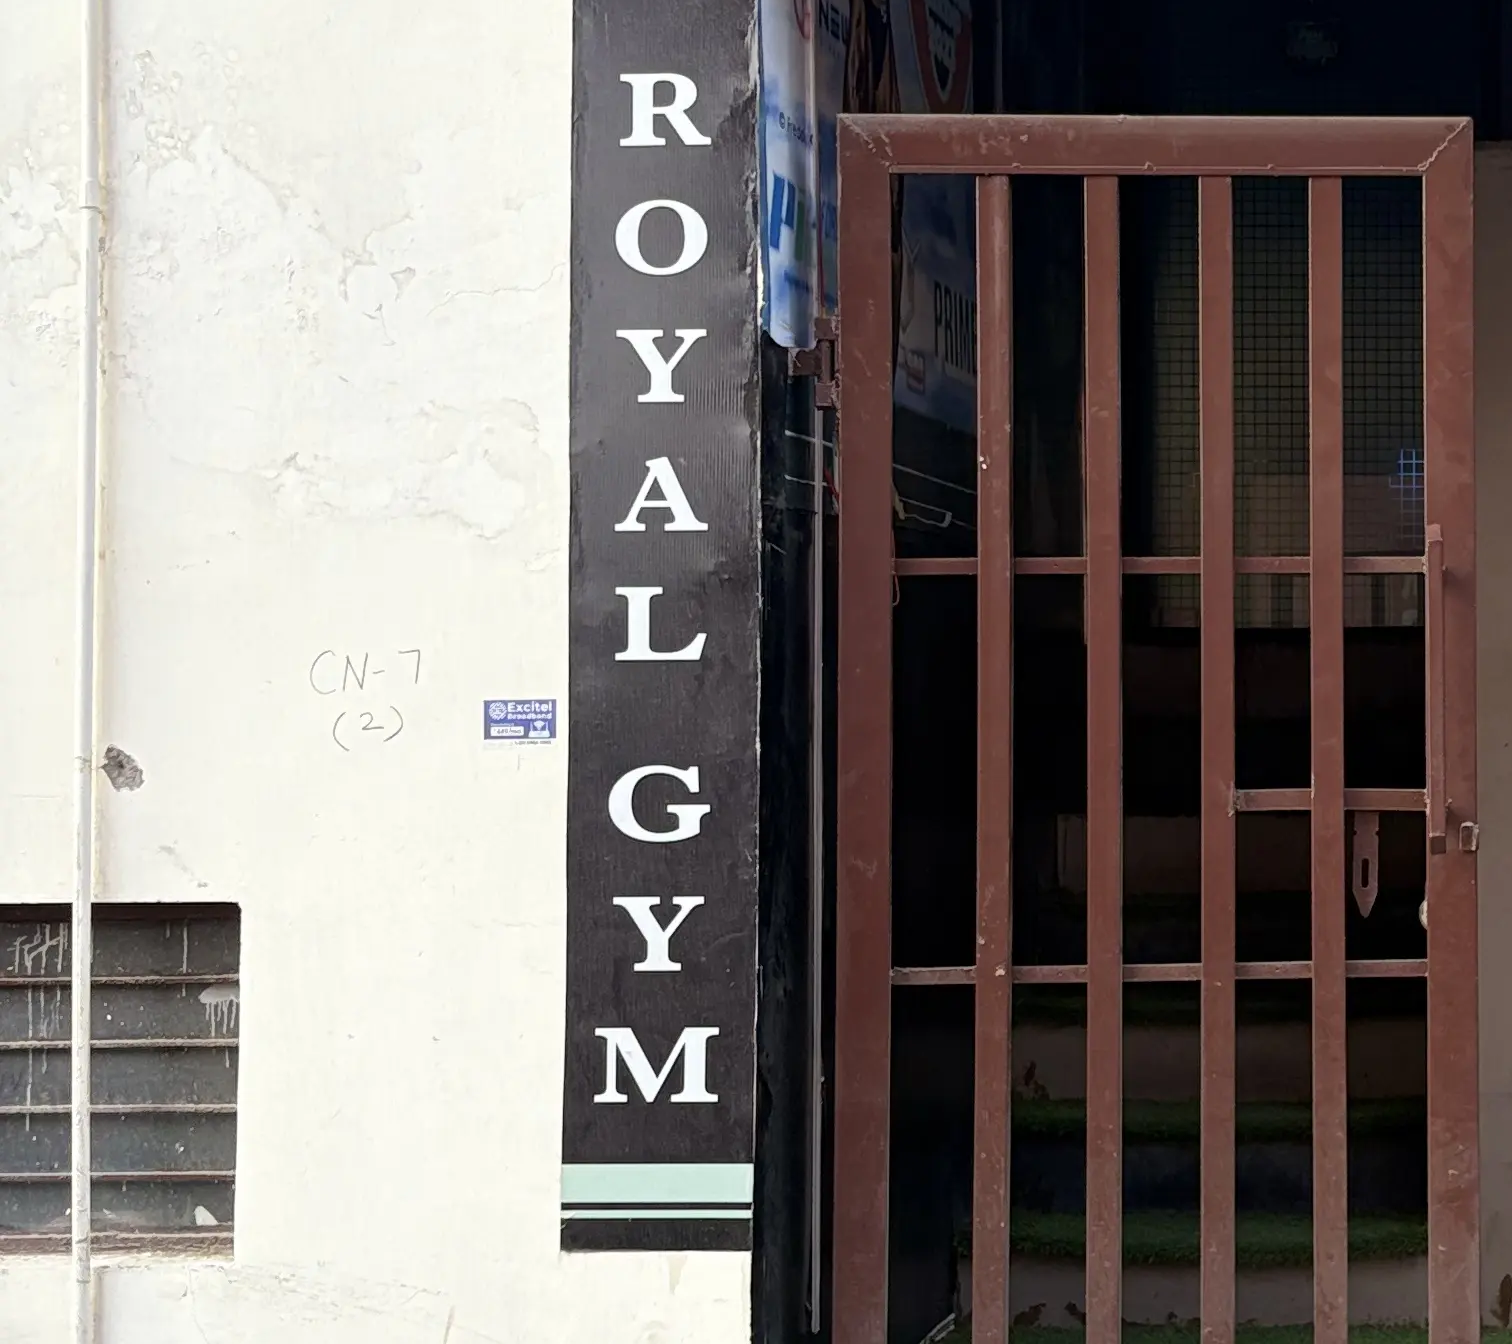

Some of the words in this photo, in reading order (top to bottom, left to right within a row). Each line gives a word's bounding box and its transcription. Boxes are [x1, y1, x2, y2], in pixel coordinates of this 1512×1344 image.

[613, 71, 713, 662] ROYAL
[333, 706, 404, 752] (2)
[507, 700, 553, 713] Excitel
[592, 763, 721, 1104] GYM
